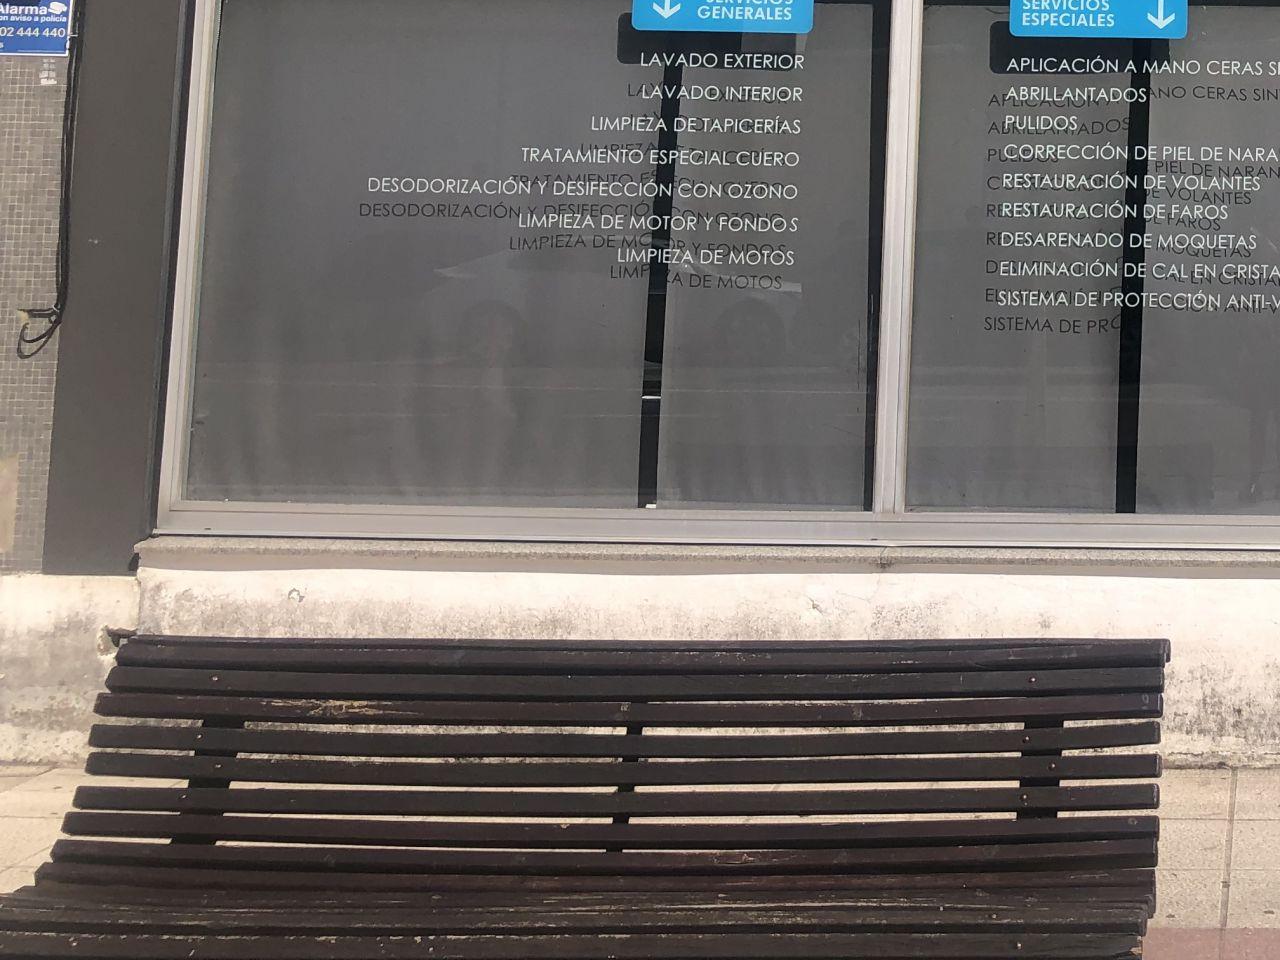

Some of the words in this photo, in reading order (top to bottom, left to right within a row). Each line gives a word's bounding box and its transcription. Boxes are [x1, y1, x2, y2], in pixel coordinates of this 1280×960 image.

[697, 5, 793, 21] GENERALES
[1022, 12, 1115, 27] ESPECIALES
[16, 27, 40, 37] 444
[42, 27, 66, 38] 440
[640, 52, 718, 68] LAVADO
[724, 53, 805, 70] EXTERIOR
[1006, 55, 1119, 73] APLICACIÓN
[1124, 58, 1138, 74] A
[1142, 59, 1201, 75] MANO
[1206, 60, 1263, 76] CERAS
[642, 84, 720, 100] LAVADO
[725, 86, 803, 102] INTERIOR
[1005, 86, 1147, 103] ABRILLANTADOS
[591, 115, 667, 132] LIMPIEZA
[673, 117, 697, 132] DE
[702, 115, 801, 135] TAPICERÍAS
[1004, 115, 1078, 131] PULIDOS
[521, 147, 644, 164] TRATAMIENTO
[650, 149, 731, 166] ESPECIAL
[736, 151, 800, 167] CUERO
[1003, 141, 1128, 160] CORRECCIÓN
[1134, 145, 1157, 161] DE
[1162, 146, 1195, 161] PIEL
[1200, 147, 1223, 161] DE
[367, 176, 531, 195] DESODORIZACIÓN
[537, 180, 550, 195] Y
[553, 179, 672, 197] DESIFECCIÓN
[678, 183, 722, 198] CON
[727, 183, 799, 200] OZONO
[1002, 171, 1137, 190] RESTAURACIÓN
[1143, 175, 1166, 190] DE
[1172, 175, 1261, 191] VOLANTES
[1001, 200, 1137, 219] RESTAURACIÓN
[1143, 204, 1166, 219] DE
[1171, 204, 1228, 220] FAROS
[518, 213, 595, 229] LIMPIEZA
[601, 214, 625, 230] DE
[635, 215, 697, 231] MOTOR
[703, 216, 714, 231] Y
[1000, 232, 1124, 248] DESARENADO
[1129, 233, 1152, 248] DE
[1157, 233, 1257, 250] MOQUETAS
[617, 248, 694, 264] LIMPIEZA
[700, 249, 724, 265] DE
[728, 250, 795, 266] MOTOS
[1000, 258, 1118, 277] ELIMINACIÓN
[1124, 262, 1147, 277] DE
[1152, 262, 1189, 279] CAL
[1194, 263, 1216, 278] EN
[998, 291, 1069, 306] SISTEMA
[1074, 291, 1097, 307] DE
[1103, 290, 1221, 309] PROTECCIÓN
